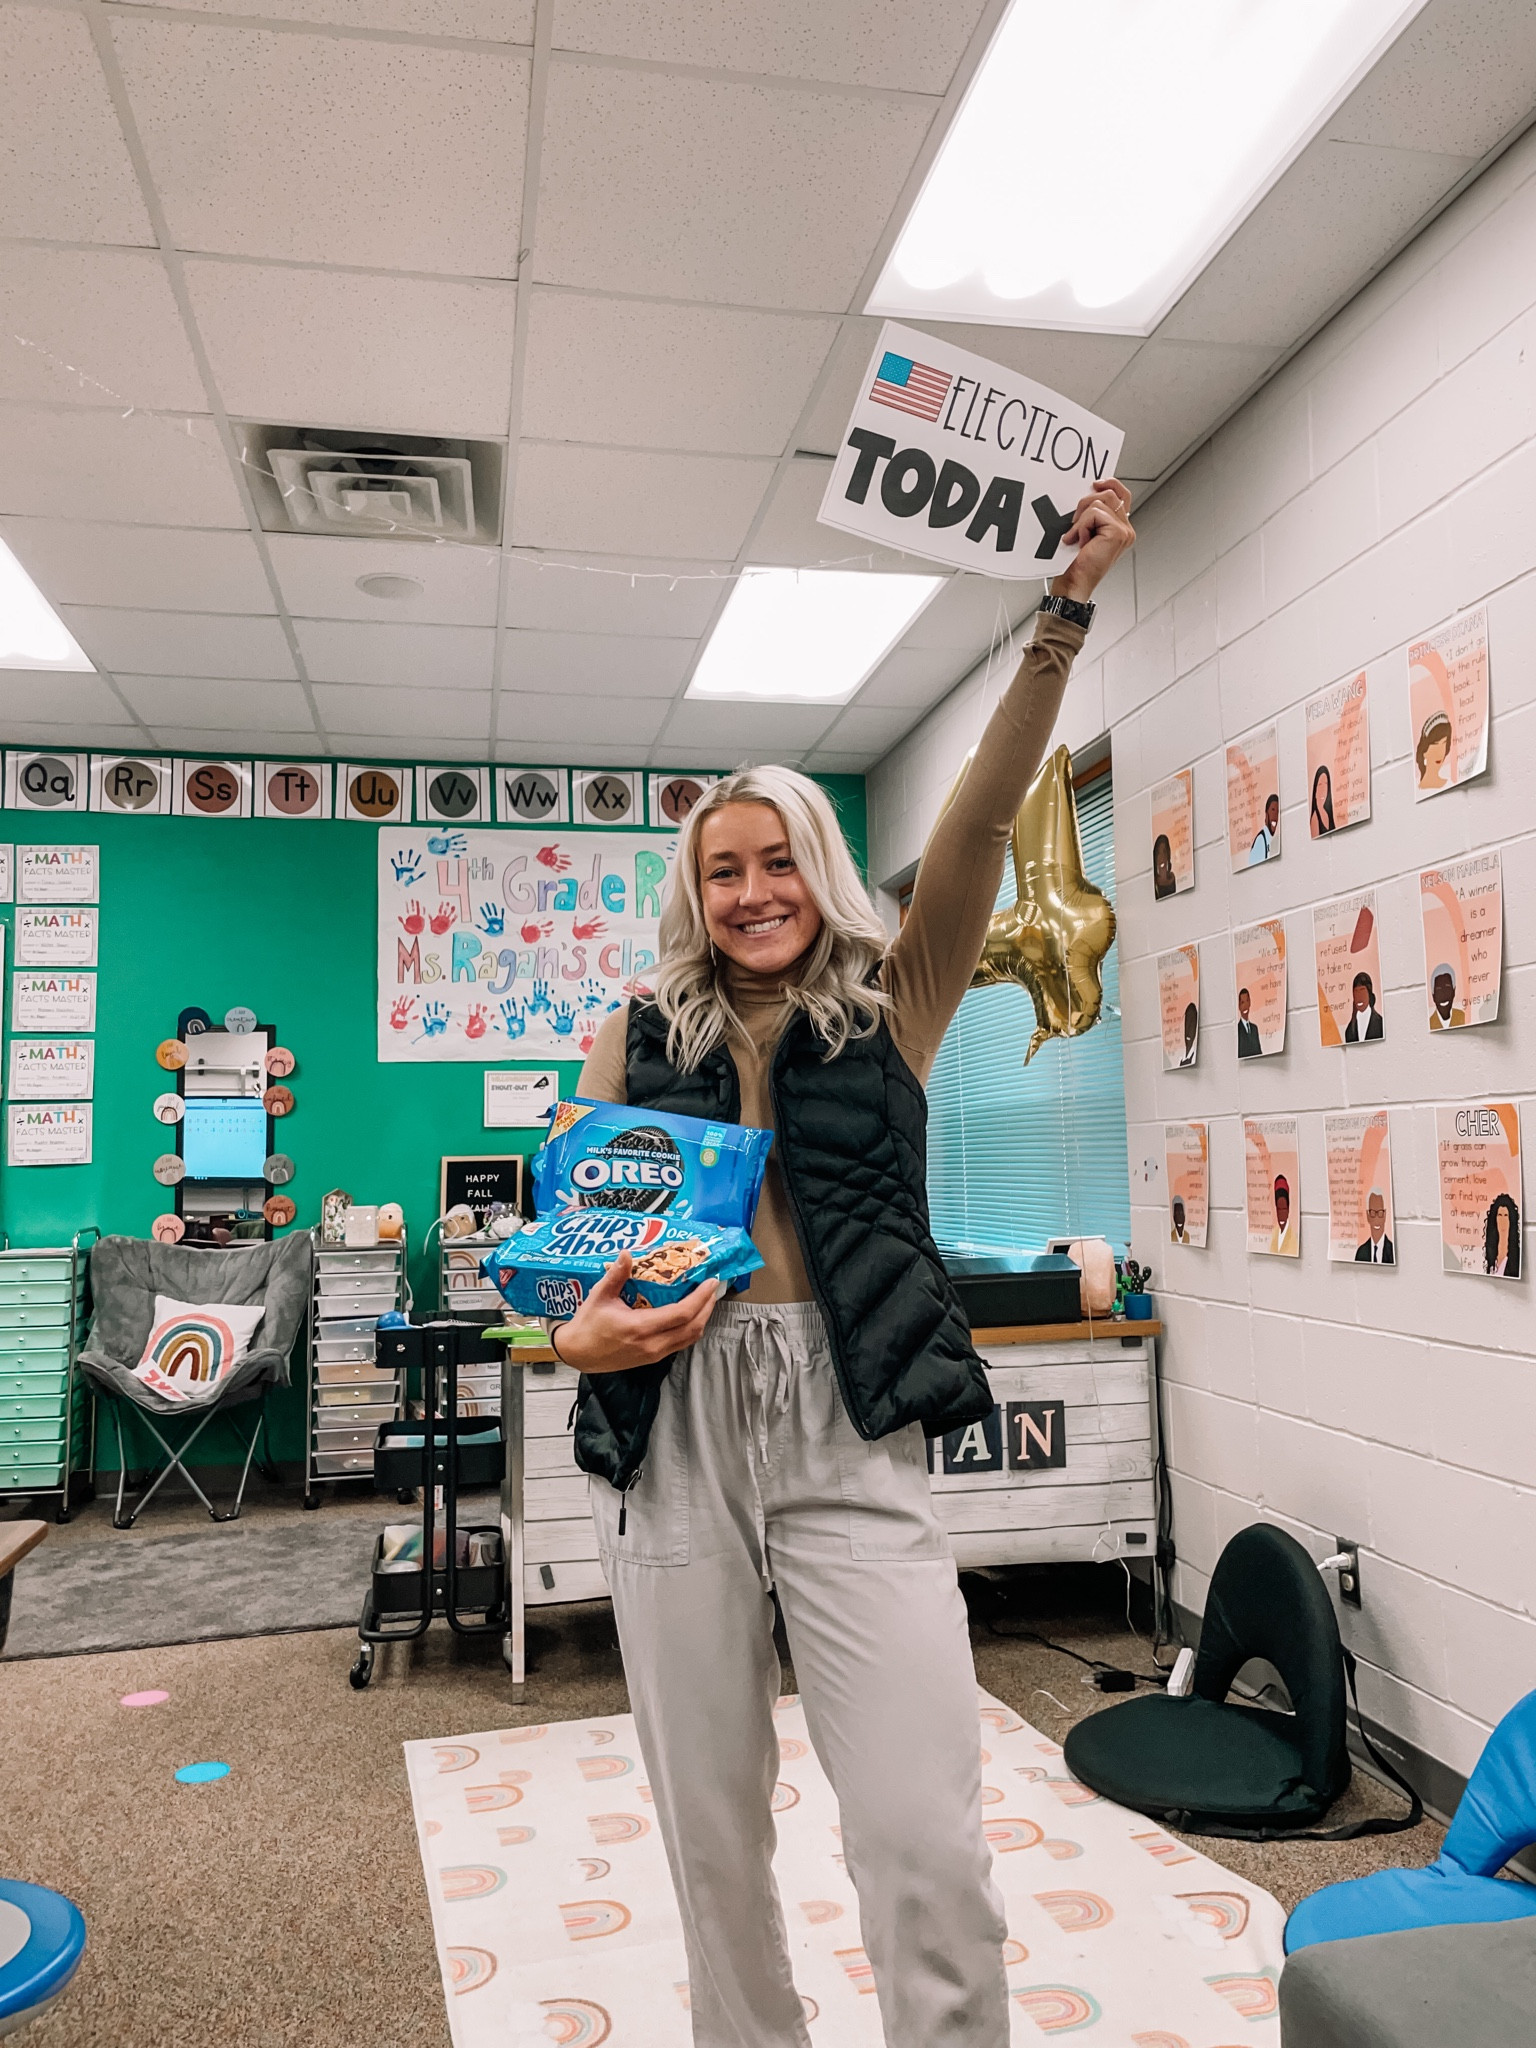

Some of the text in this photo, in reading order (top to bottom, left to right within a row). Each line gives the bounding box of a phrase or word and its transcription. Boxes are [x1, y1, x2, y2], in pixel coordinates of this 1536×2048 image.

[943, 376, 1109, 480] ELECTION
[845, 427, 1076, 559] TODAY
[1458, 662, 1469, 671] the
[1460, 692, 1474, 707] lead
[1459, 712, 1476, 725] from
[24, 762, 75, 802] Qq
[114, 766, 153, 797] Rr
[195, 771, 232, 801] Ss
[277, 772, 310, 801] Tt
[356, 775, 394, 806] Uu
[435, 777, 473, 806] Vv
[505, 780, 559, 808] Ww
[591, 780, 625, 809] Xx
[35, 853, 82, 864] MATH
[24, 868, 91, 876] FACTS MASTER
[1421, 854, 1499, 890] NELSON MANDELA
[436, 856, 494, 923] 4th
[502, 853, 626, 915] Grade
[1468, 882, 1497, 897] winner
[1470, 908, 1485, 918] is a
[34, 915, 81, 927] MATH
[23, 930, 91, 938] FACTS MASTER
[1460, 927, 1496, 942] dreamer
[1320, 940, 1347, 957] refused
[1471, 948, 1487, 962] who
[397, 936, 446, 984] Ms.
[452, 931, 587, 994] Ragan's
[1267, 962, 1285, 974] change
[1318, 962, 1352, 977] to take no
[1270, 980, 1282, 989] have
[1468, 972, 1490, 984] never
[31, 980, 80, 992] MATH
[1325, 982, 1346, 993] for an
[20, 995, 89, 1003] FACTS MASTER
[1462, 996, 1480, 1010] gives
[29, 1047, 77, 1060] MATH
[18, 1063, 86, 1071] FACTS MASTER
[27, 1112, 75, 1125] MATH
[1456, 1109, 1500, 1136] CHER
[16, 1127, 85, 1136] FACTS MASTER
[586, 1147, 681, 1161] MILK'S FAVORITE COOKIE
[1453, 1143, 1472, 1153] grass
[1441, 1157, 1488, 1169] grow through
[466, 1174, 499, 1183] HAPPY
[573, 1159, 683, 1188] OREO
[1473, 1174, 1487, 1184] love
[467, 1189, 493, 1197] FALL
[1459, 1190, 1472, 1200] find
[1451, 1208, 1480, 1218] at every
[555, 1214, 645, 1238] Chips
[1456, 1223, 1471, 1234] time
[1460, 1244, 1475, 1252] your
[537, 1281, 574, 1301] Chips
